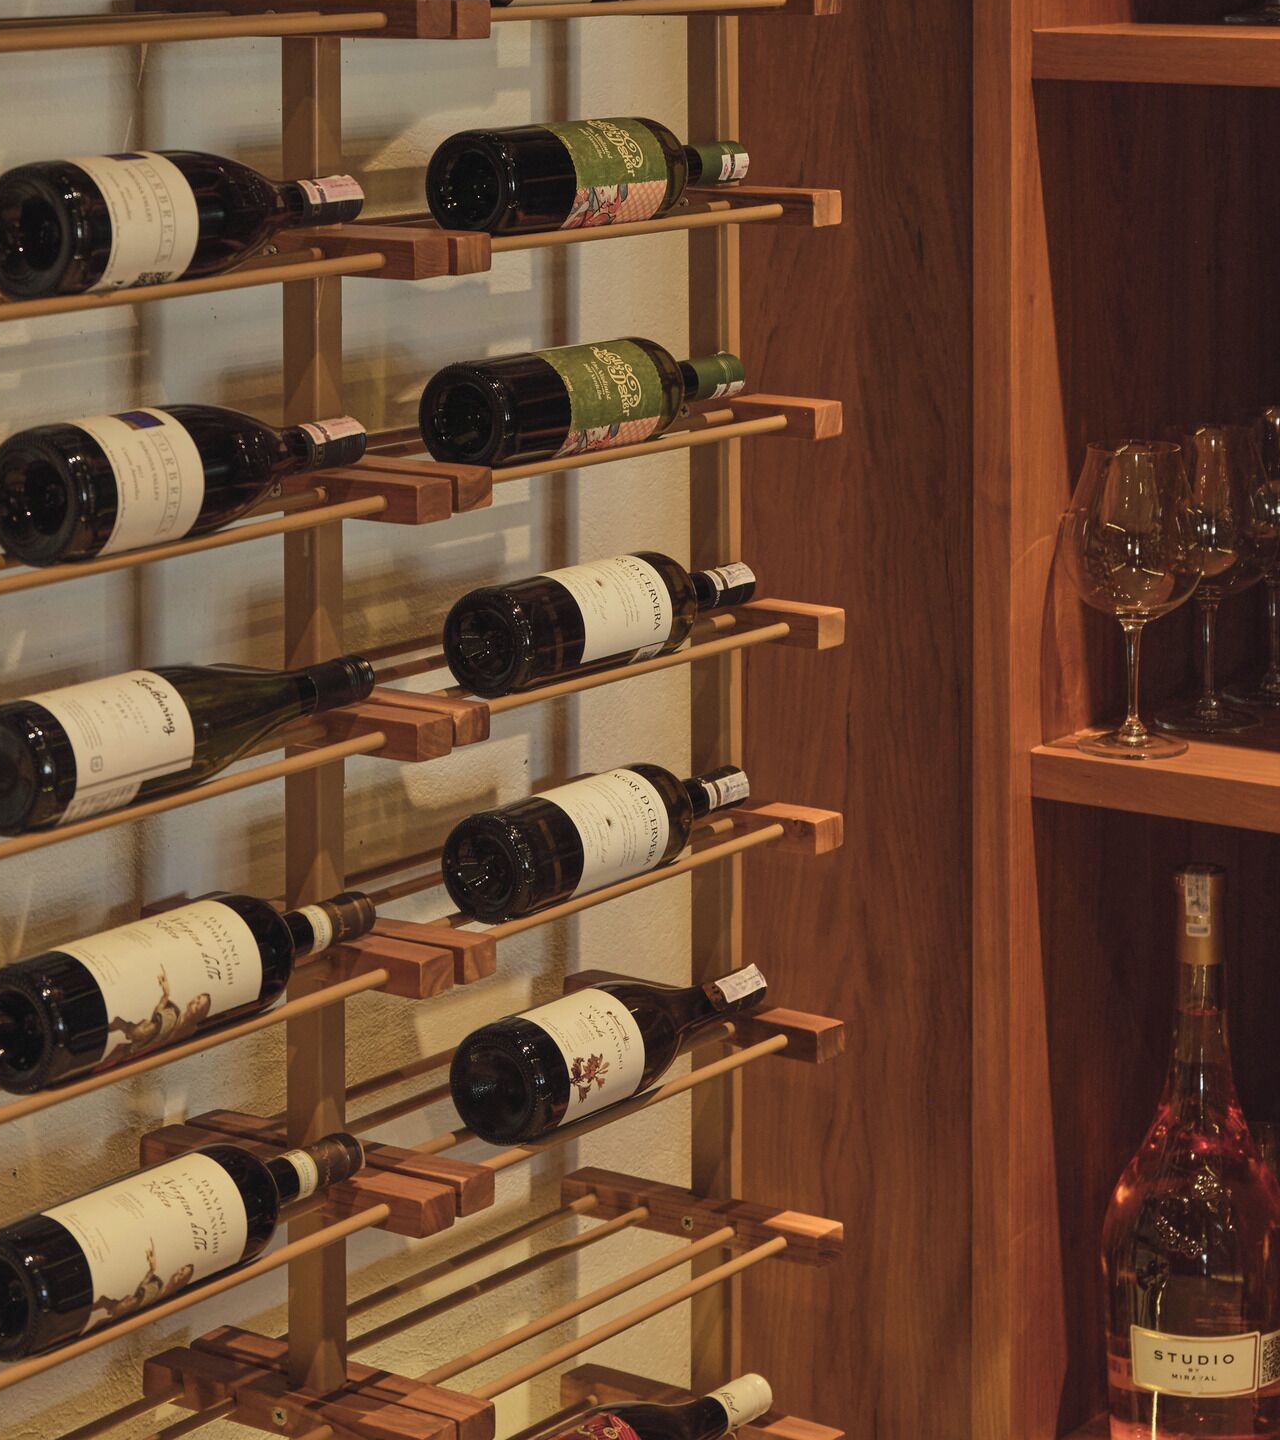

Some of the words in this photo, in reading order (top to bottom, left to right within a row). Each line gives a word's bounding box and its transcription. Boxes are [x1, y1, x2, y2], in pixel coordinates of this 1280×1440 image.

[639, 572, 662, 631] CERVERA
[642, 808, 658, 867] CERVERA
[223, 930, 240, 966] VINCI
[201, 952, 222, 981] delle
[213, 1197, 227, 1235] VINCI
[190, 1222, 208, 1251] delle
[1153, 1349, 1235, 1366] STUDIO
